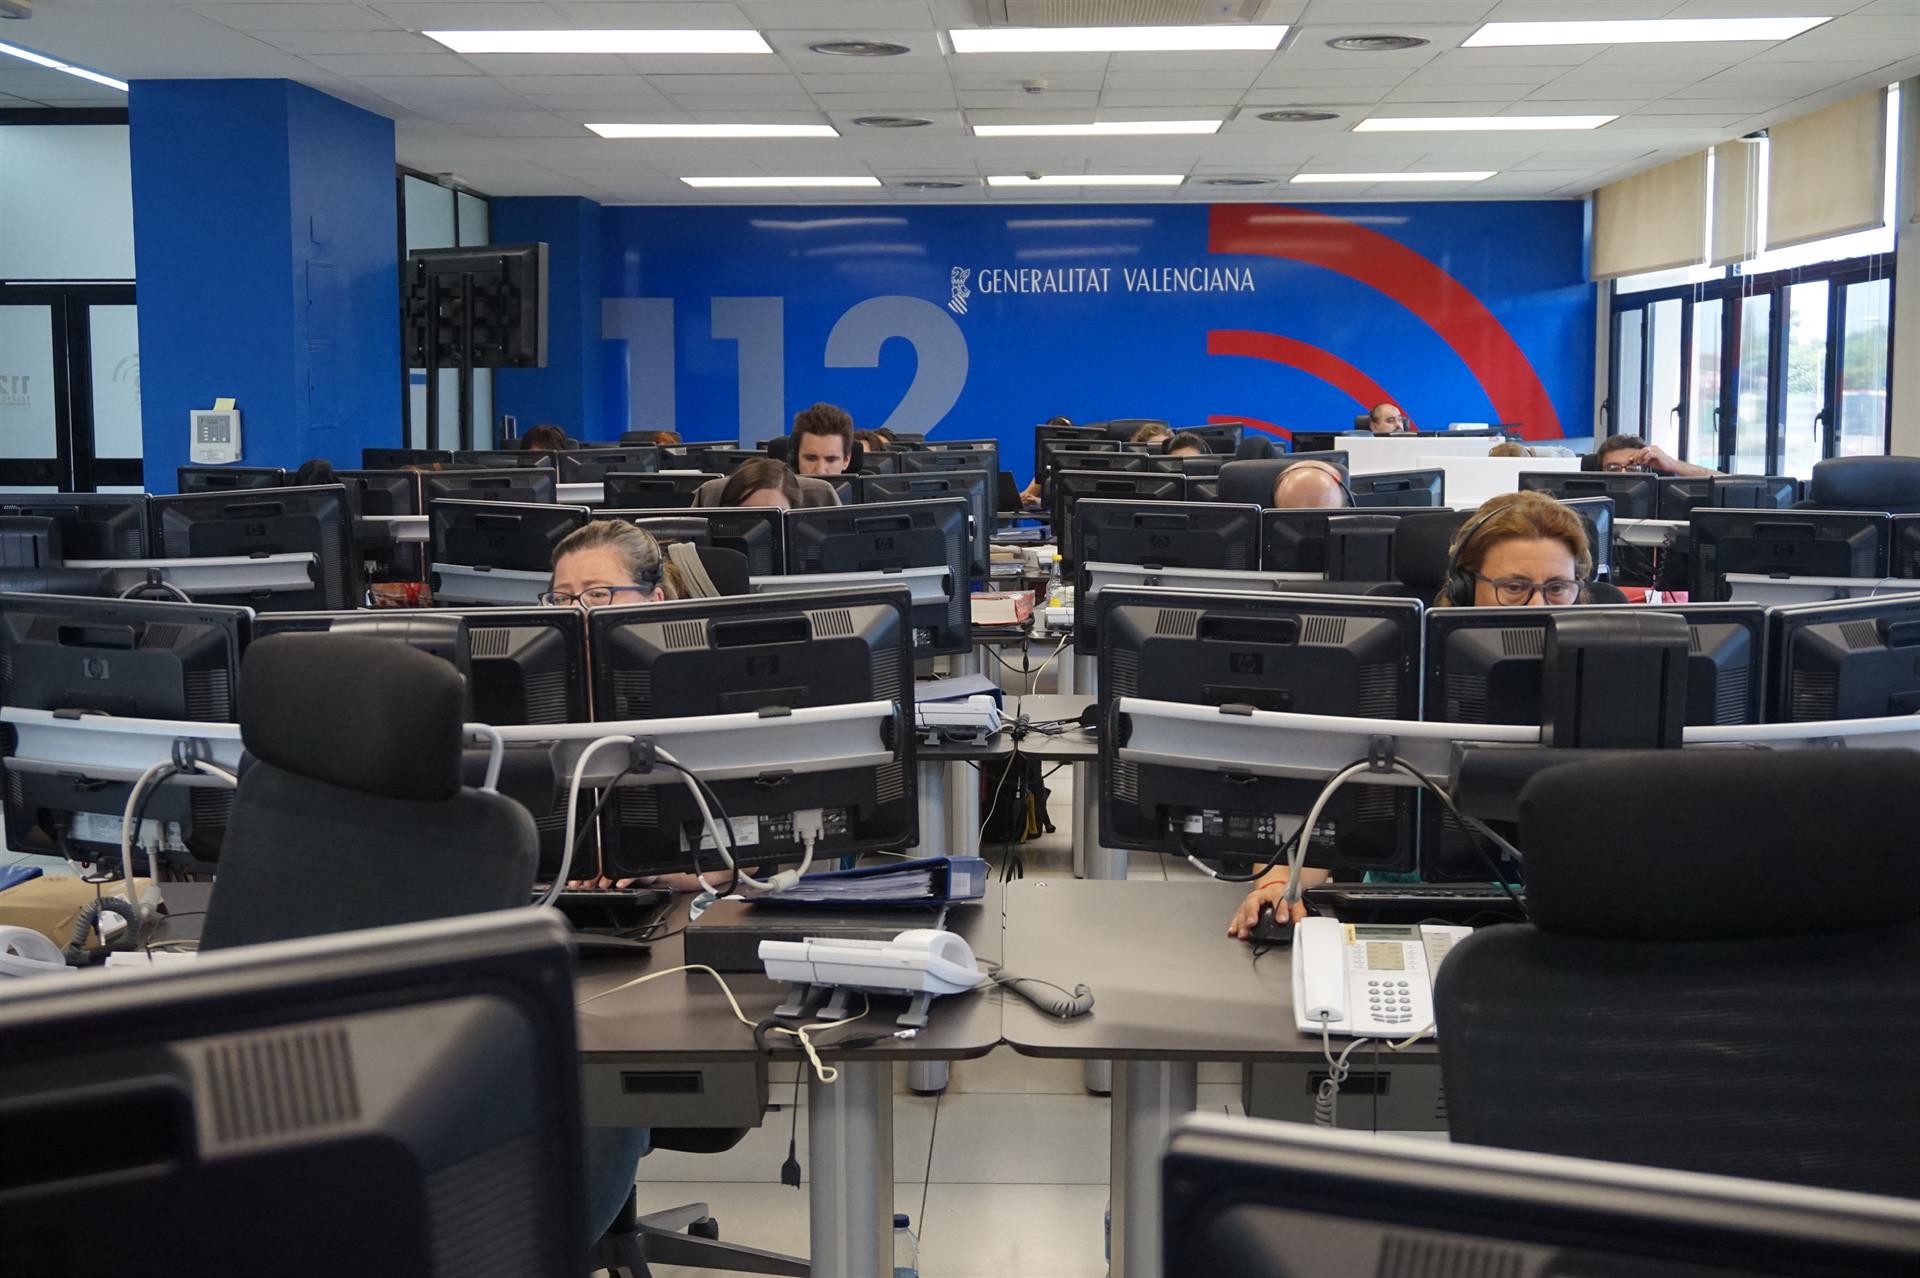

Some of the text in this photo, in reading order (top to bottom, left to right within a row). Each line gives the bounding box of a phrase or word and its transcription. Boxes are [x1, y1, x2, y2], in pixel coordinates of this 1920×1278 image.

[978, 267, 1255, 293] GENERALITAT VALENCIANA
[601, 295, 969, 450] 112
